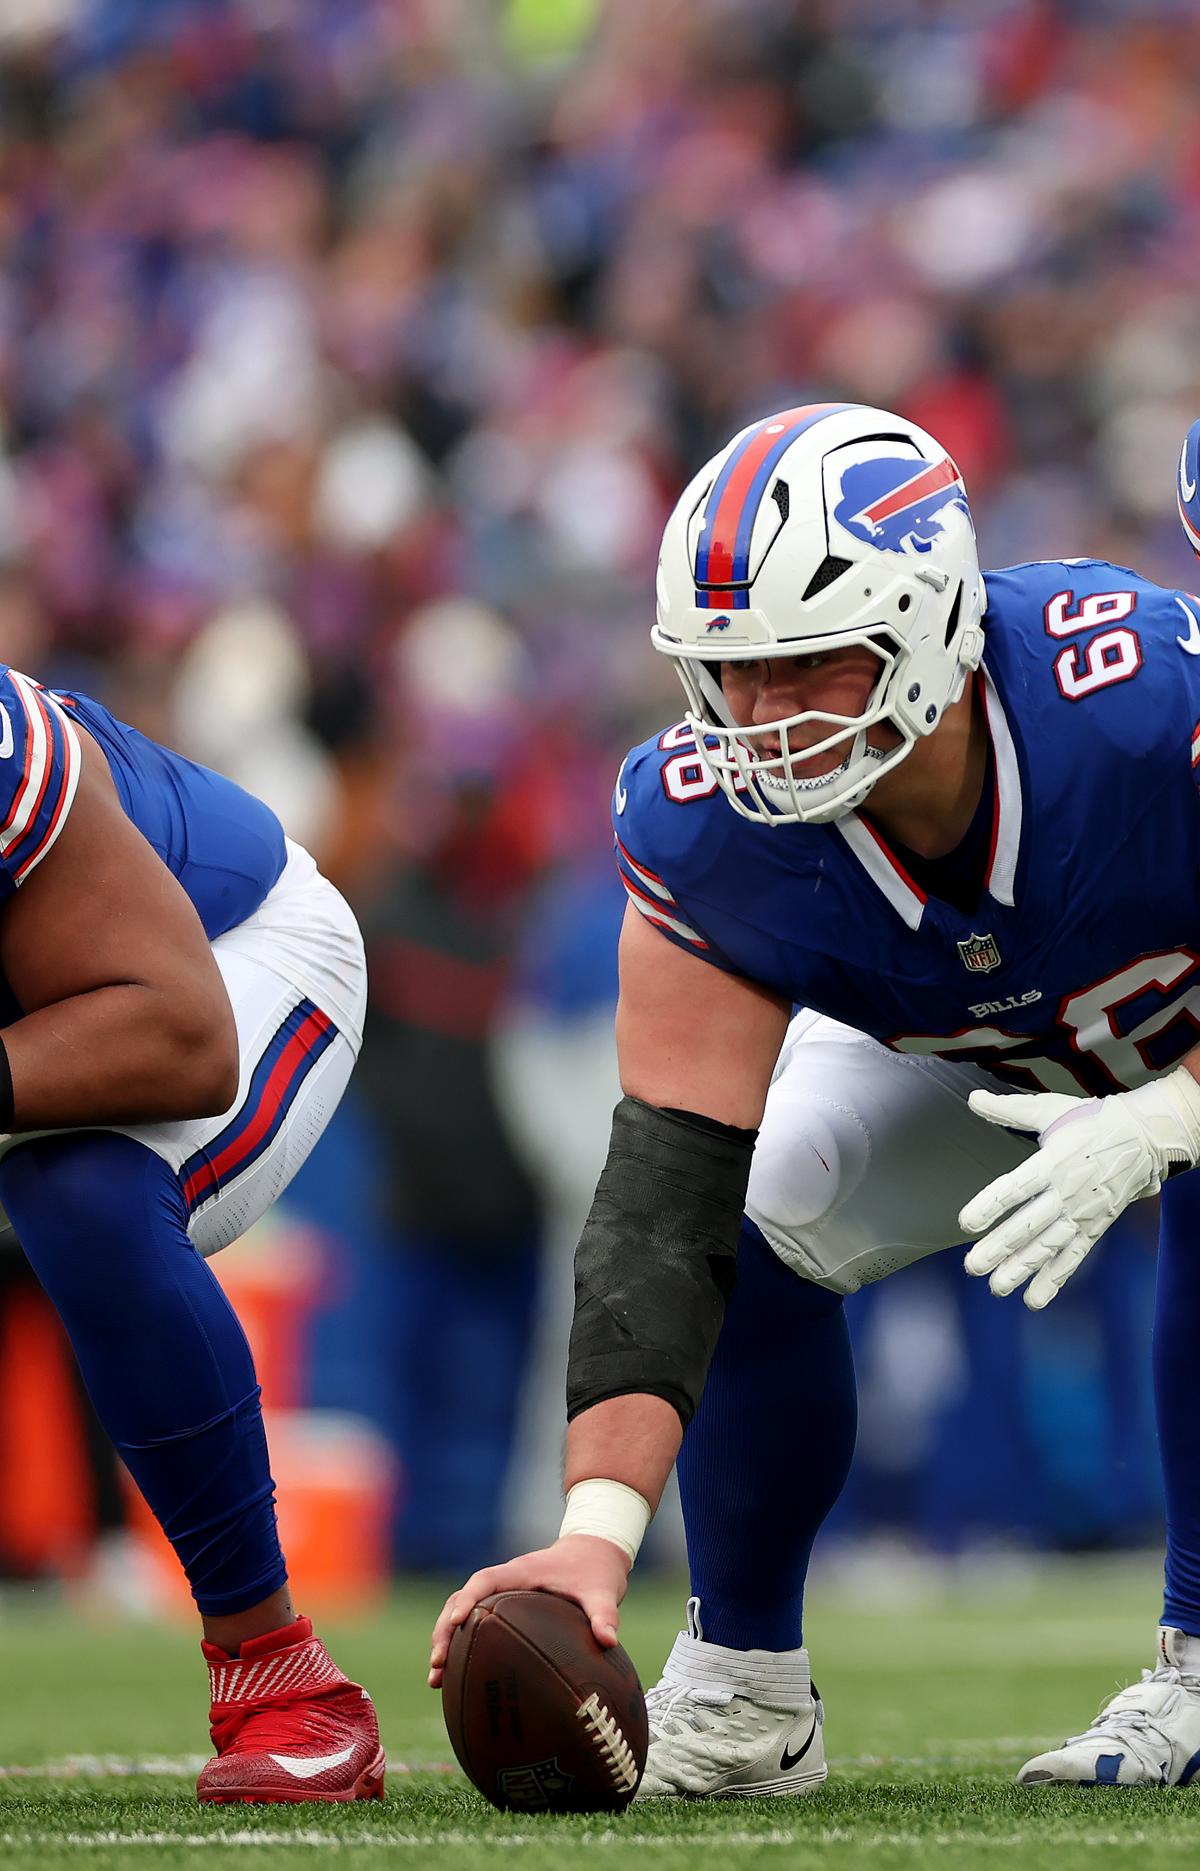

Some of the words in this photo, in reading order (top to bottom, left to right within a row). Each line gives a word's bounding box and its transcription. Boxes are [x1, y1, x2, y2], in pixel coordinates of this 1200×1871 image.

[1044, 589, 1146, 701] 66
[967, 951, 996, 968] NFL
[968, 989, 1042, 1018] BILLS
